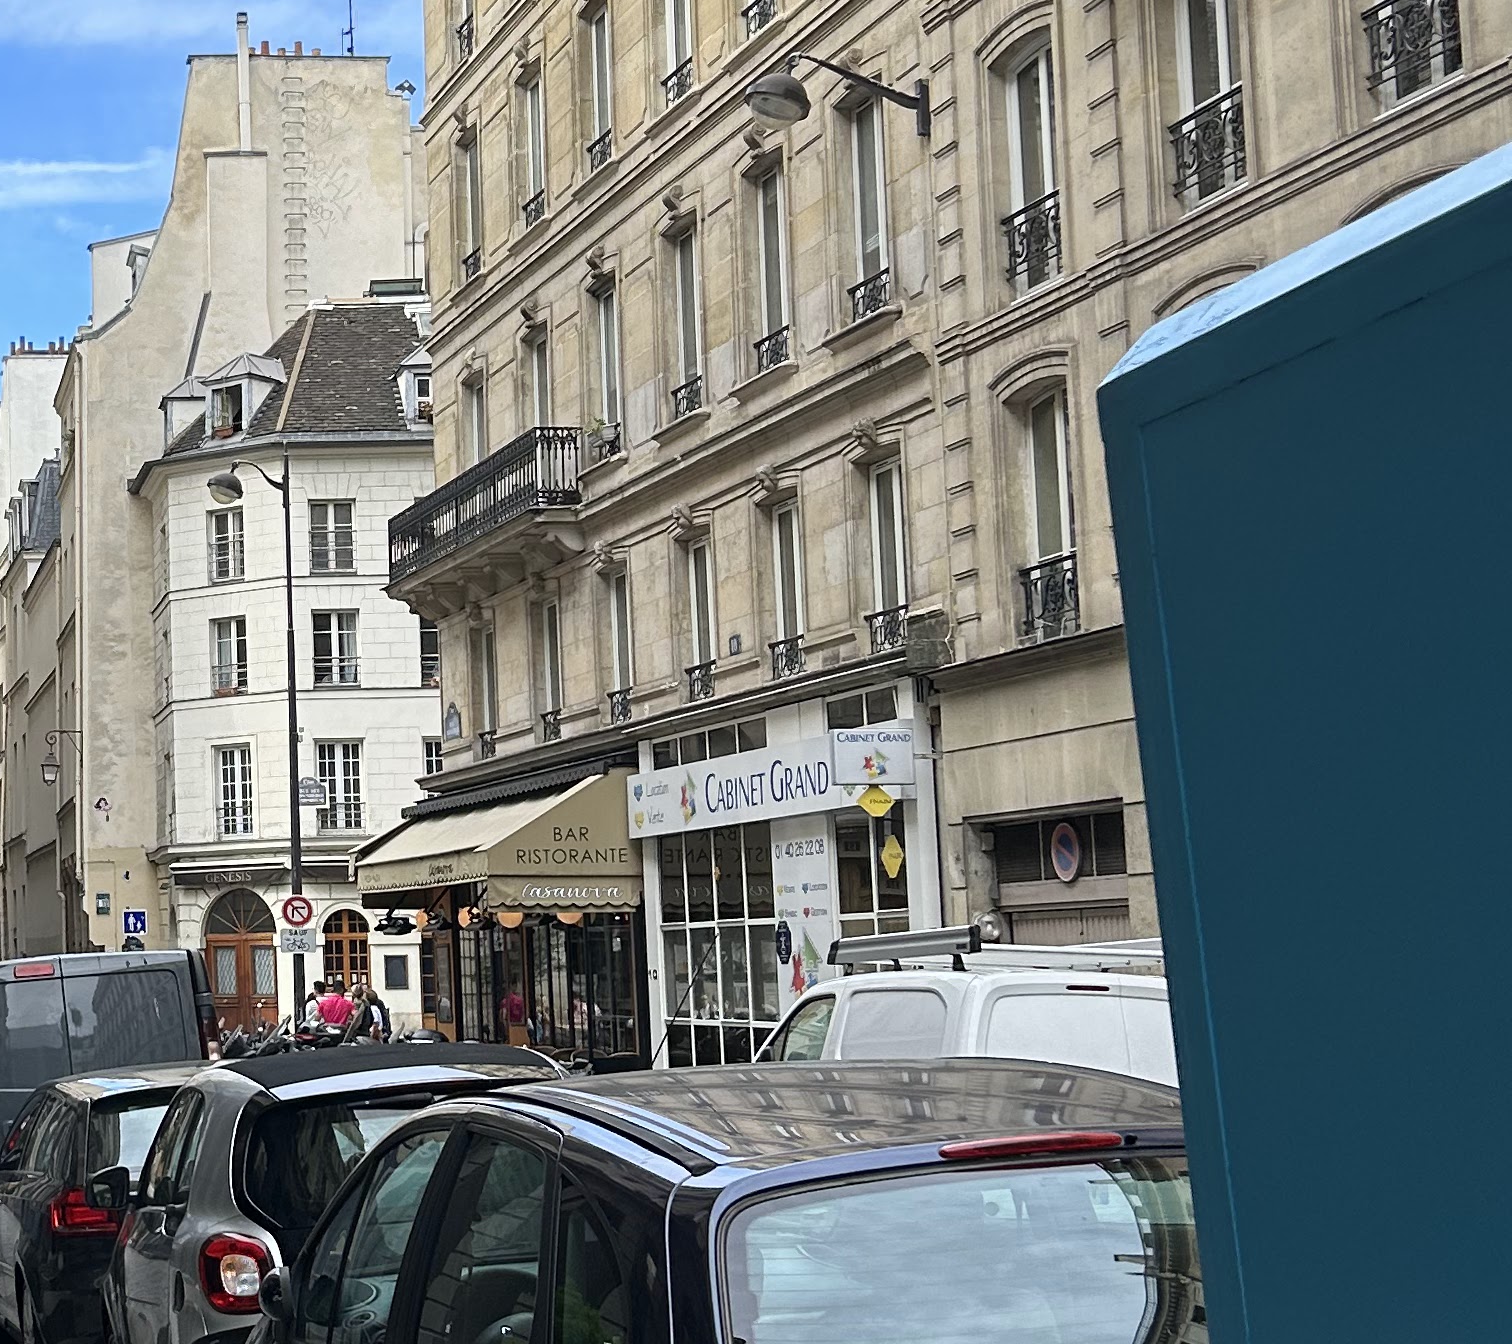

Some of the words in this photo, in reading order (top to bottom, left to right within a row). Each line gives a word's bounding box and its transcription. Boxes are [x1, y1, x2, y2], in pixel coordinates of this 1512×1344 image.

[705, 773, 766, 813] CABINET
[770, 759, 829, 803] GRAND
[552, 826, 589, 842] BAR
[516, 847, 628, 865] RISTORANTE
[205, 871, 252, 883] GENESIS
[521, 883, 624, 899] Casanova
